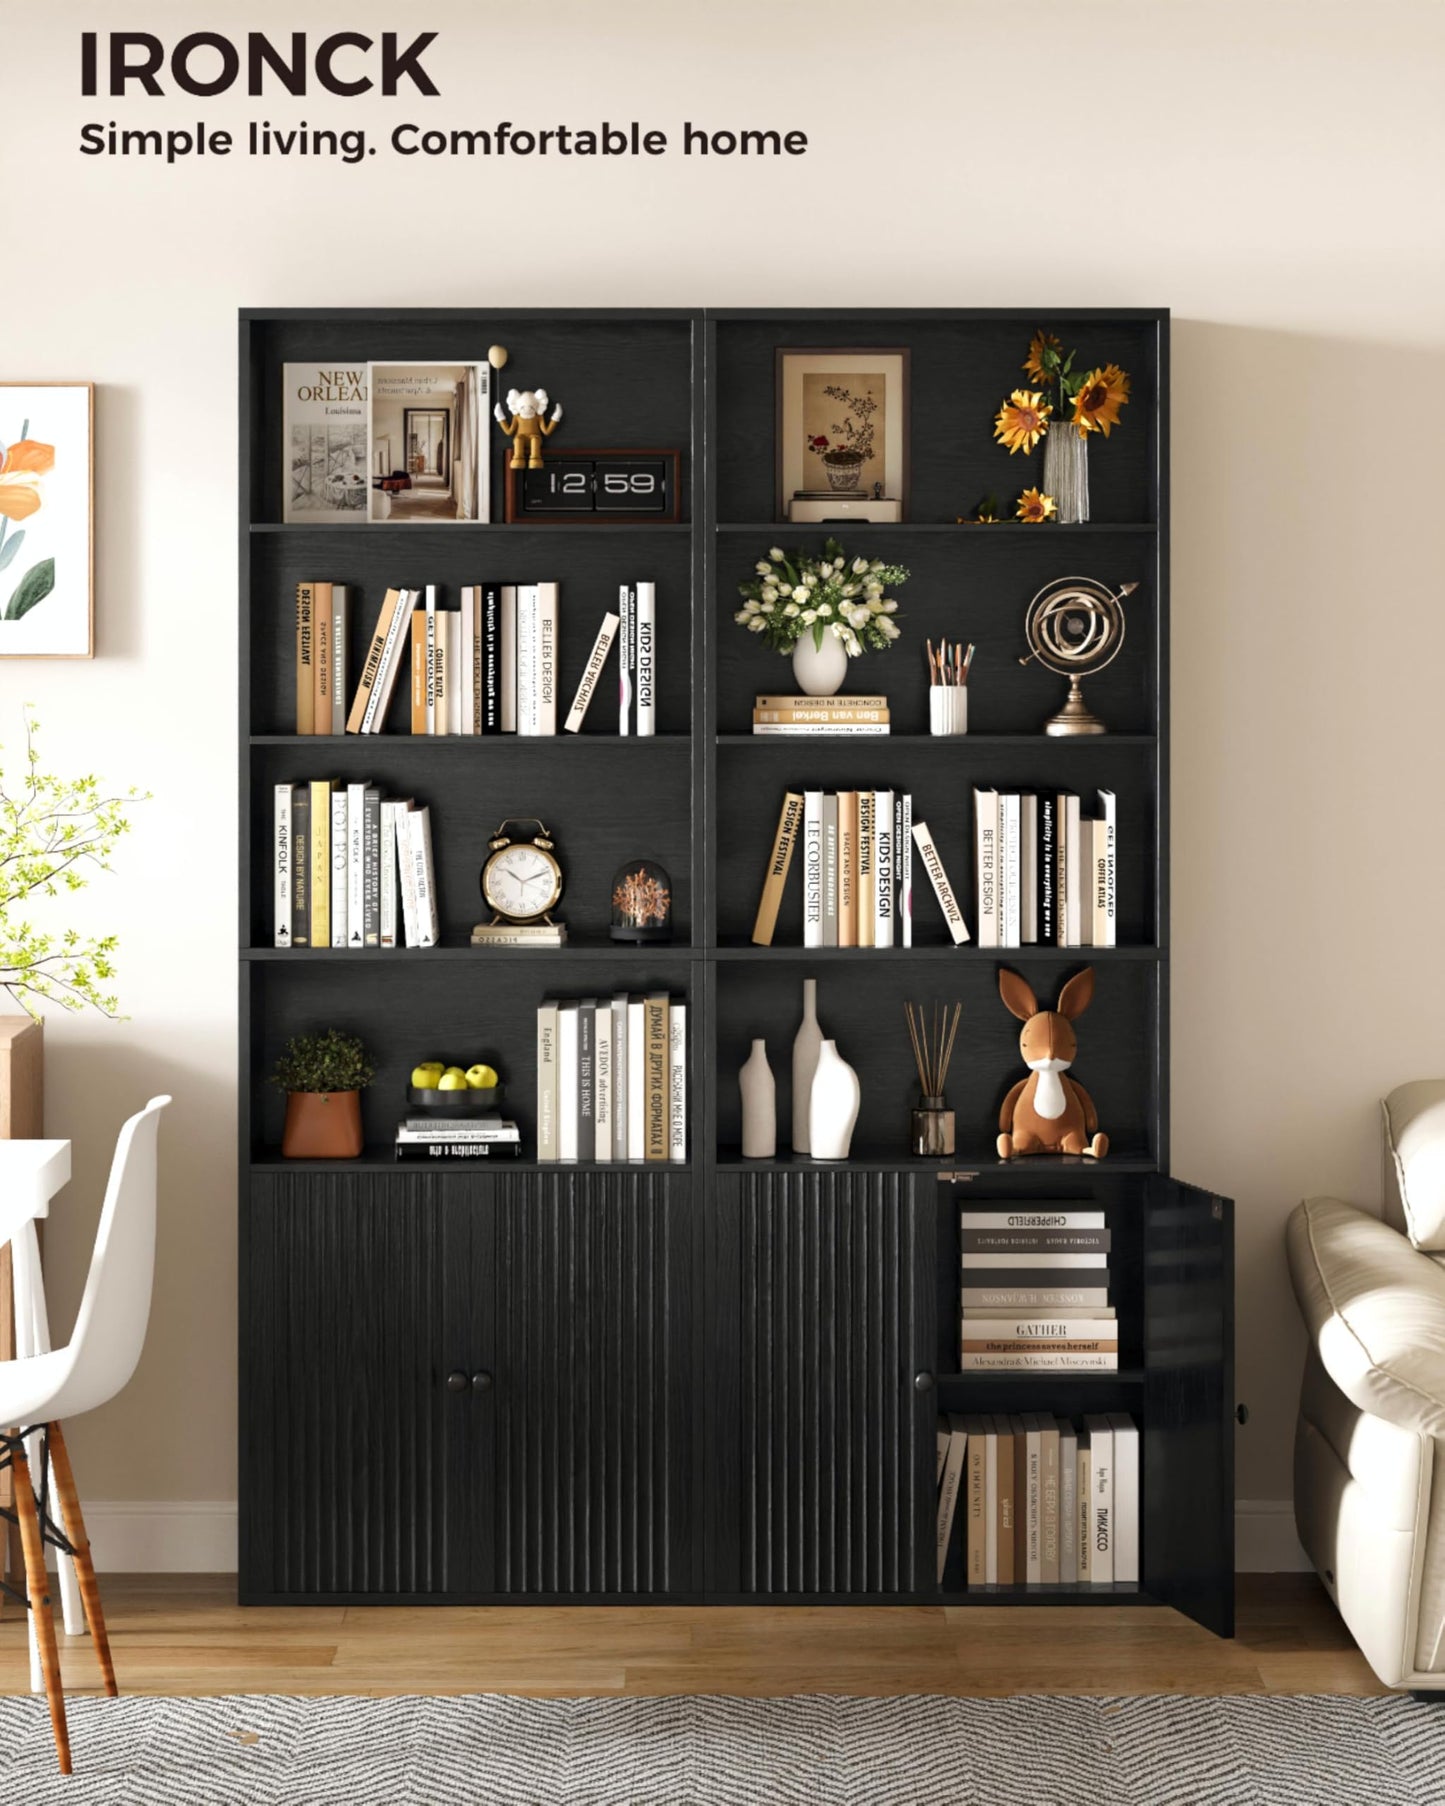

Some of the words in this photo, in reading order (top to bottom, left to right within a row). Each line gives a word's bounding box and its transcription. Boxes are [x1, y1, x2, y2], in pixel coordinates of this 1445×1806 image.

[297, 386, 368, 401] ORLEA
[318, 371, 363, 386] NEW
[551, 473, 586, 493] 12
[604, 474, 655, 493] 59
[361, 635, 384, 688] MINIMALISM
[792, 711, 829, 722] Berkel
[832, 711, 853, 722] van
[856, 711, 879, 722] Ben
[782, 800, 798, 834] DESIGN
[808, 820, 820, 838] LE
[861, 799, 870, 832] DESIGN
[1044, 801, 1052, 842] simplicity
[278, 825, 288, 874] KINFOLK
[296, 834, 304, 864] DESIGN
[772, 836, 790, 876] FESTIVAL
[861, 836, 870, 876] FESTIVAL
[880, 832, 890, 863] KIDS
[984, 829, 993, 868] BETTER
[1044, 854, 1052, 862] in
[296, 866, 304, 876] BY
[808, 840, 820, 922] CORBUSIER
[922, 844, 942, 881] BETTER
[937, 879, 960, 924] ARCHVIZ
[1044, 864, 1052, 908] everything
[1098, 858, 1106, 884] COFFEE
[296, 878, 304, 910] NATURE
[880, 867, 890, 918] DESIGN
[984, 872, 993, 914] DESIGN
[1098, 886, 1106, 908] ATLAS
[1044, 910, 1052, 921] we
[1044, 923, 1052, 938] see
[650, 1006, 665, 1040] ДУМАЙ
[543, 1028, 552, 1062] England
[600, 1038, 608, 1076] AVEDON
[582, 1056, 590, 1076] THIS
[650, 1052, 662, 1090] ДРУГИХ
[582, 1079, 590, 1088] IS
[582, 1089, 590, 1117] HOME
[598, 1078, 608, 1124] advertising
[652, 1093, 662, 1145] ФОРМАТАХ
[1008, 1216, 1066, 1226] CHIPPERFIELD
[1016, 1324, 1066, 1336] GATHER
[1097, 1508, 1108, 1552] ПИКАССО
